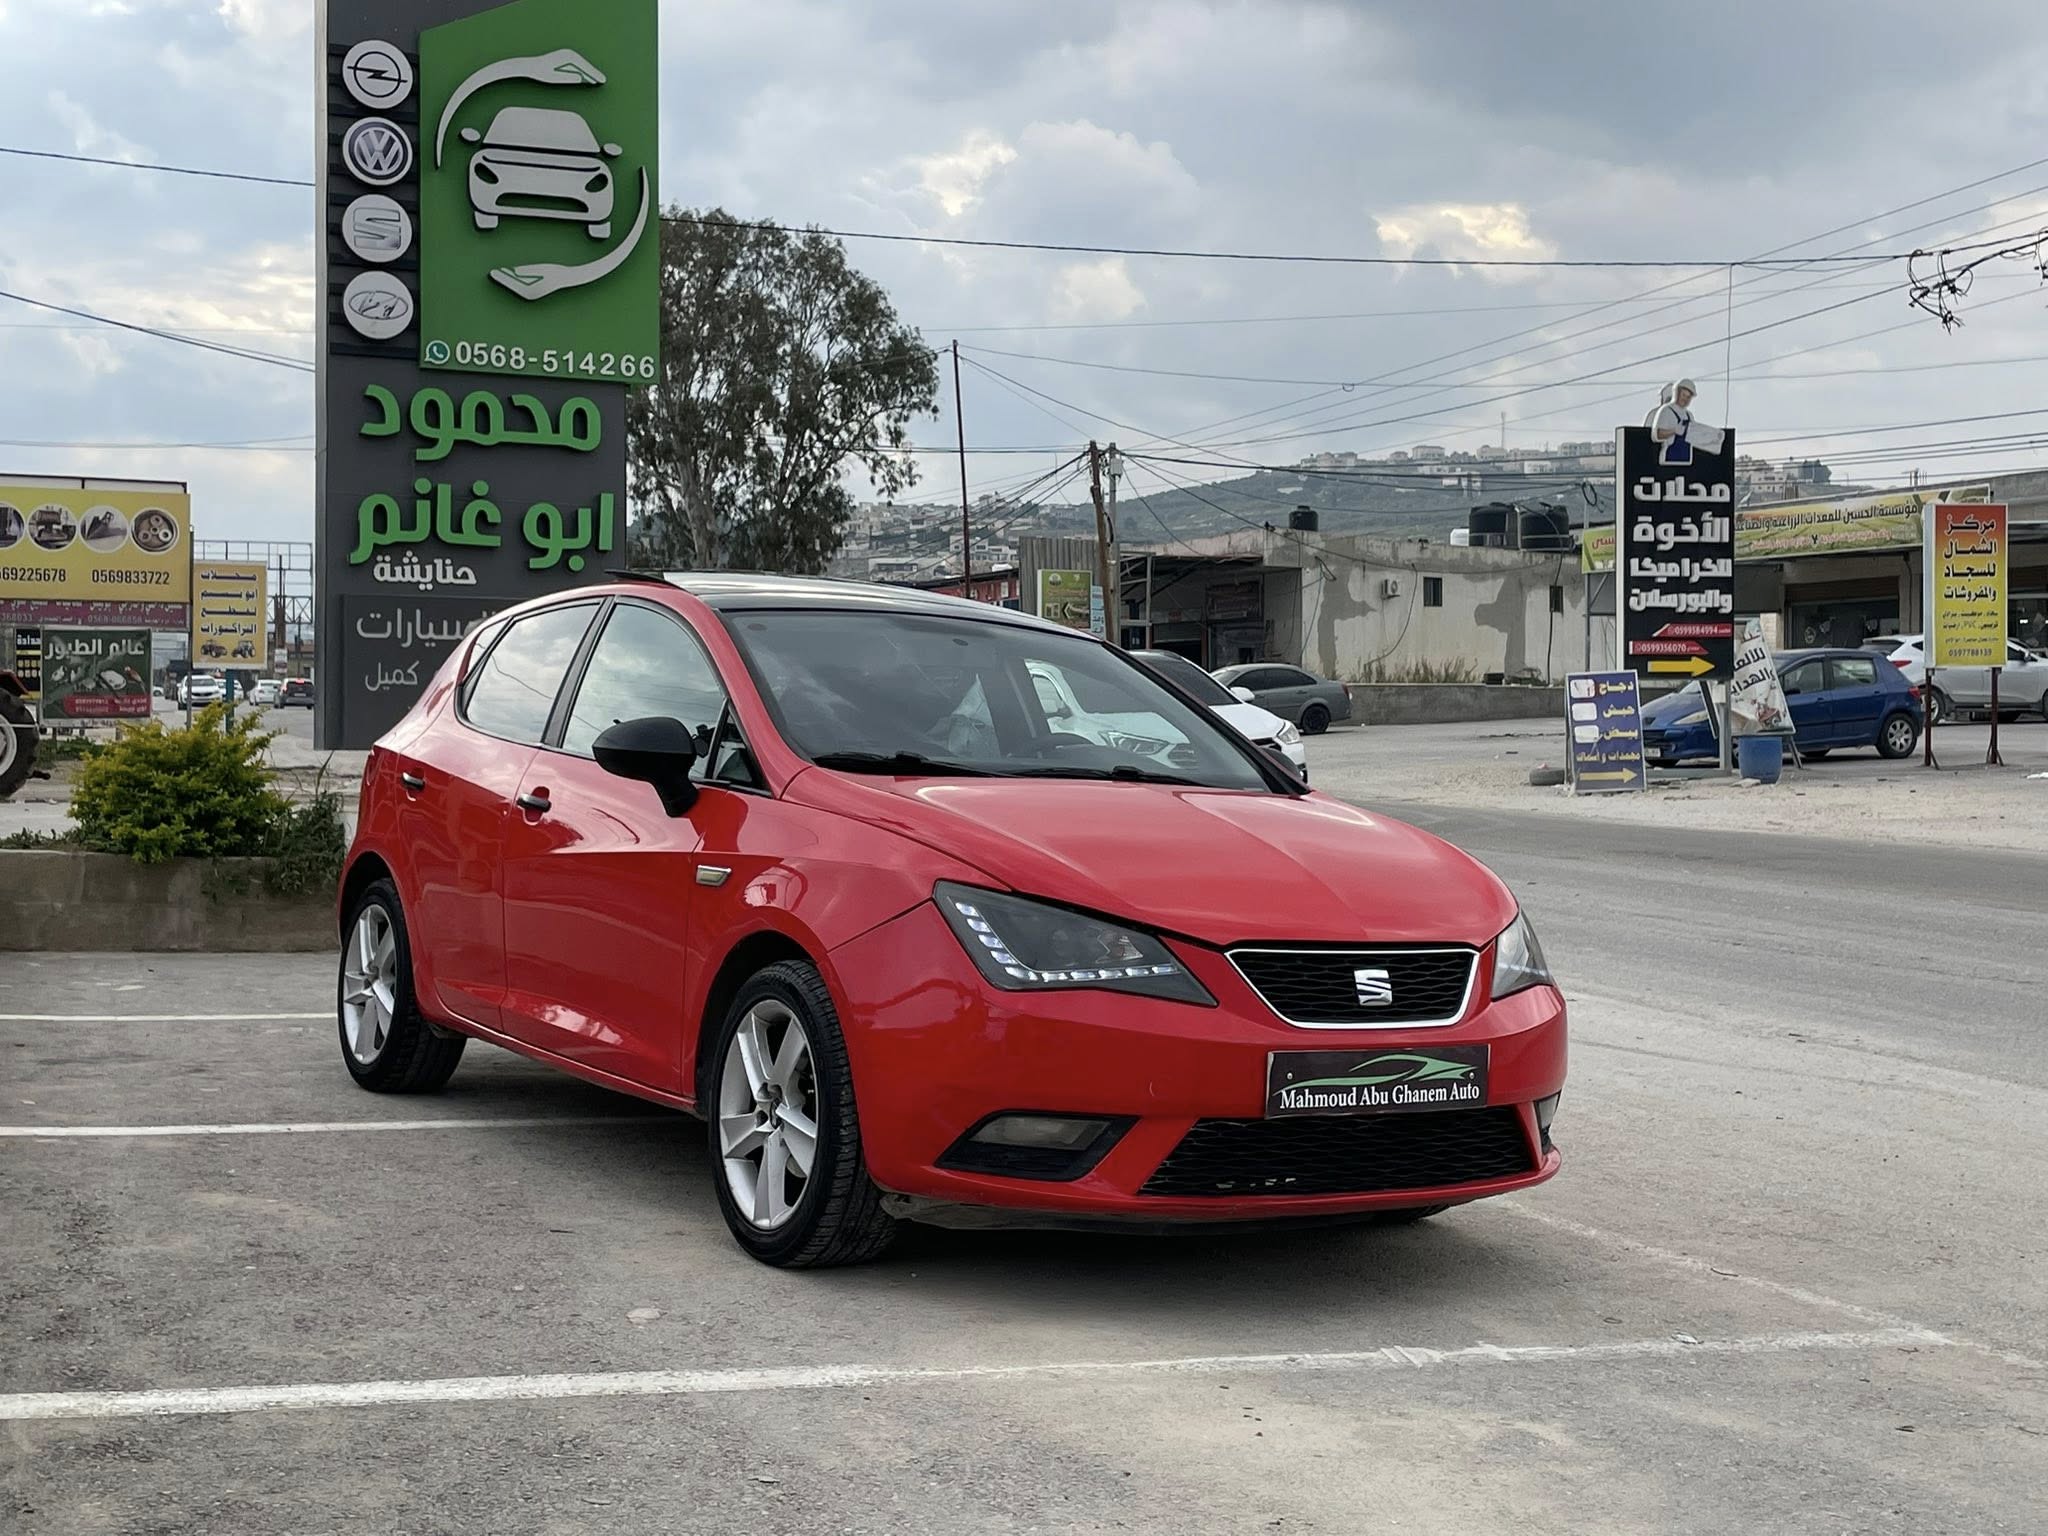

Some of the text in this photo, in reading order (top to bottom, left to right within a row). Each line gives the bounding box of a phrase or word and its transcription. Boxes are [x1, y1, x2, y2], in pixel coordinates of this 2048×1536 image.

[455, 341, 655, 378] 0568-514266
[359, 384, 601, 461] محمود
[1633, 476, 1731, 502] محلات
[347, 477, 614, 572] ابو غانم
[1633, 511, 1730, 551] الأخوة
[1945, 513, 1995, 535] مركز
[1944, 536, 1997, 559] الشمال
[0, 567, 170, 585] 69225678 0569833722
[373, 551, 477, 590] حنايشة
[1944, 562, 1997, 582] للسجاد
[1629, 588, 1732, 614] والبورسلان
[1944, 585, 1997, 602] والمفروشات
[44, 639, 145, 660] عالم الطيور
[365, 660, 420, 691] كميل
[1599, 681, 1634, 696] دجاج
[1280, 1082, 1480, 1109] Mahmoud Abu Ghanem Auto
